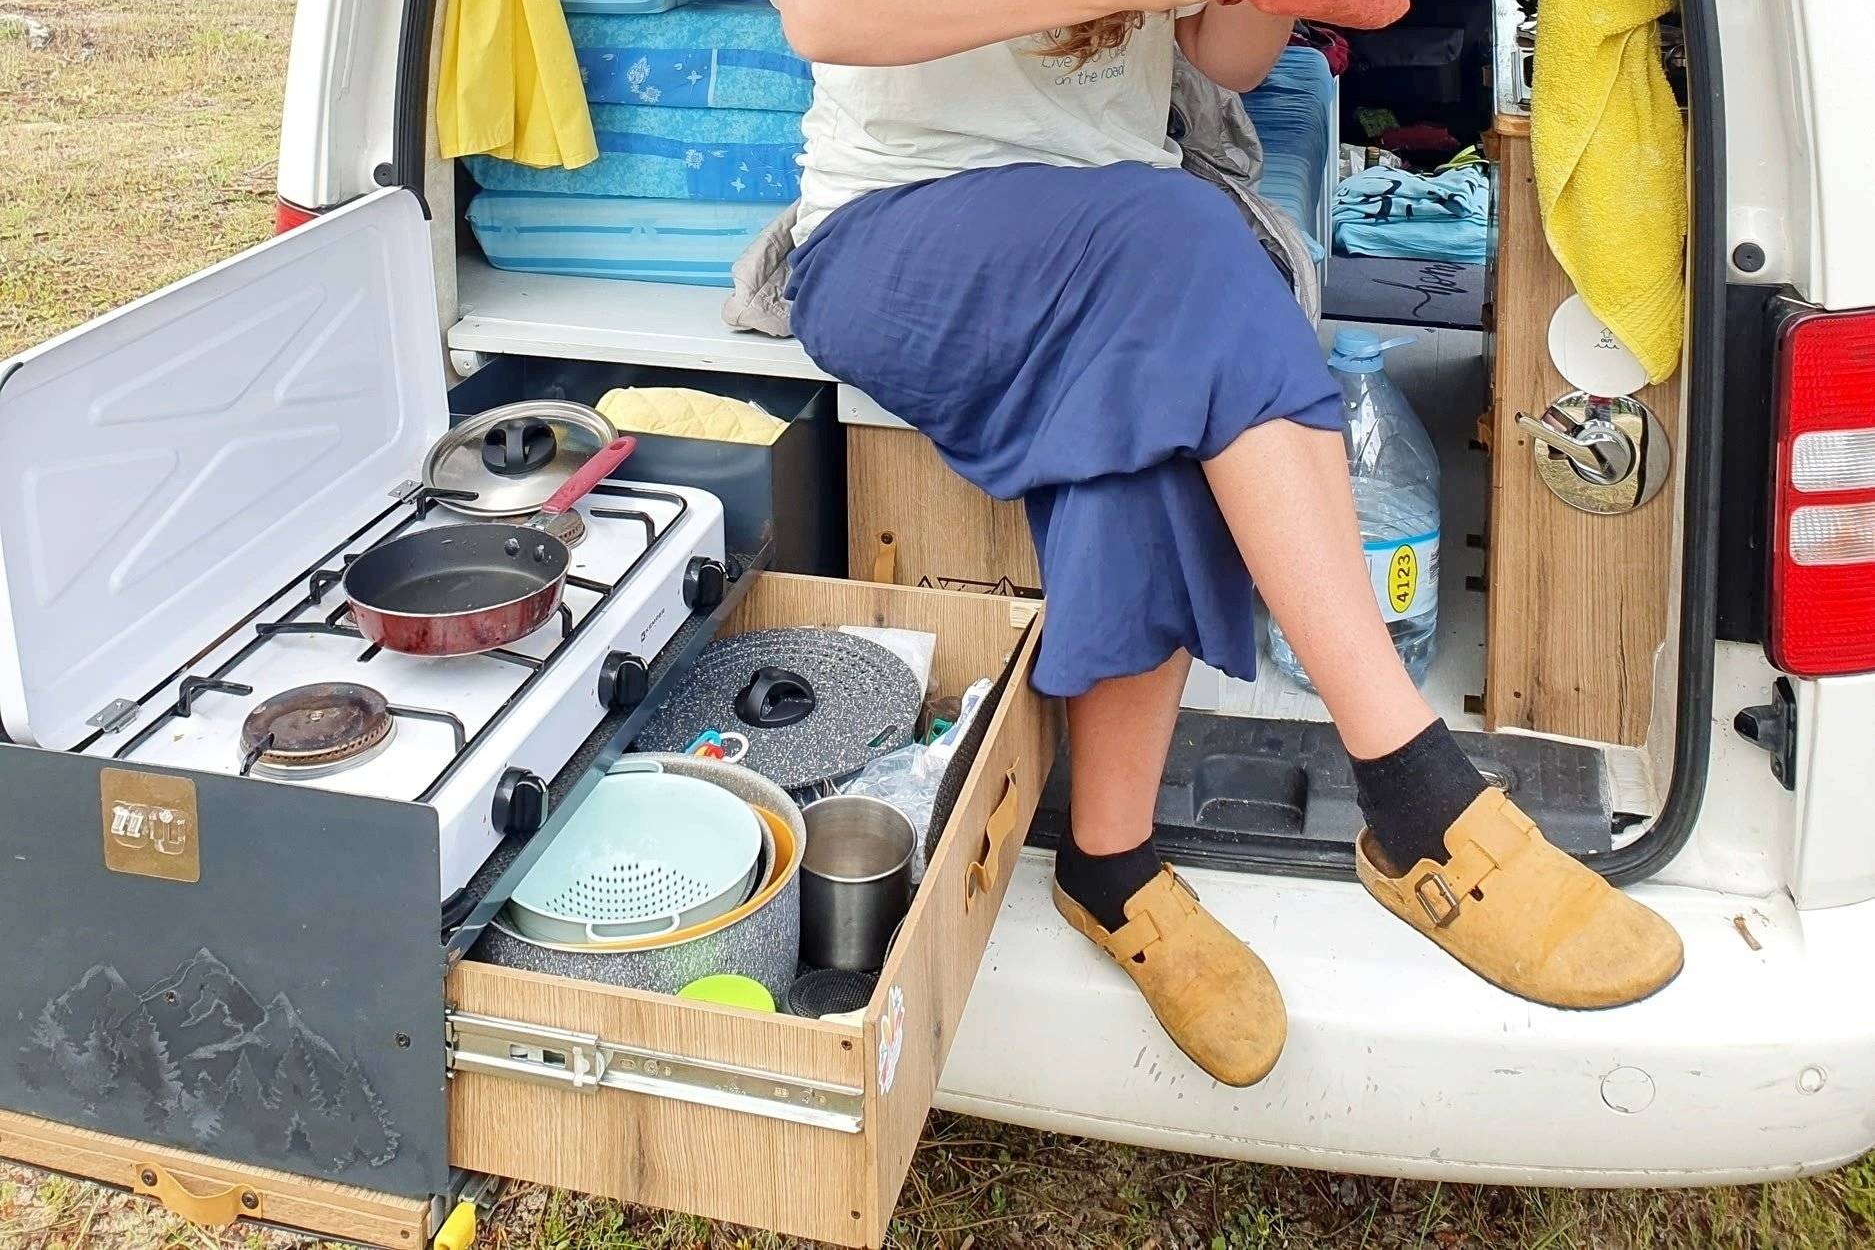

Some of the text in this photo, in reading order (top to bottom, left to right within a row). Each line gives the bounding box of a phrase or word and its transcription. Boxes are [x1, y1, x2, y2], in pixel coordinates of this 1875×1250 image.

[1077, 70, 1098, 85] the
[1100, 59, 1126, 79] road
[1396, 553, 1411, 603] 4123
